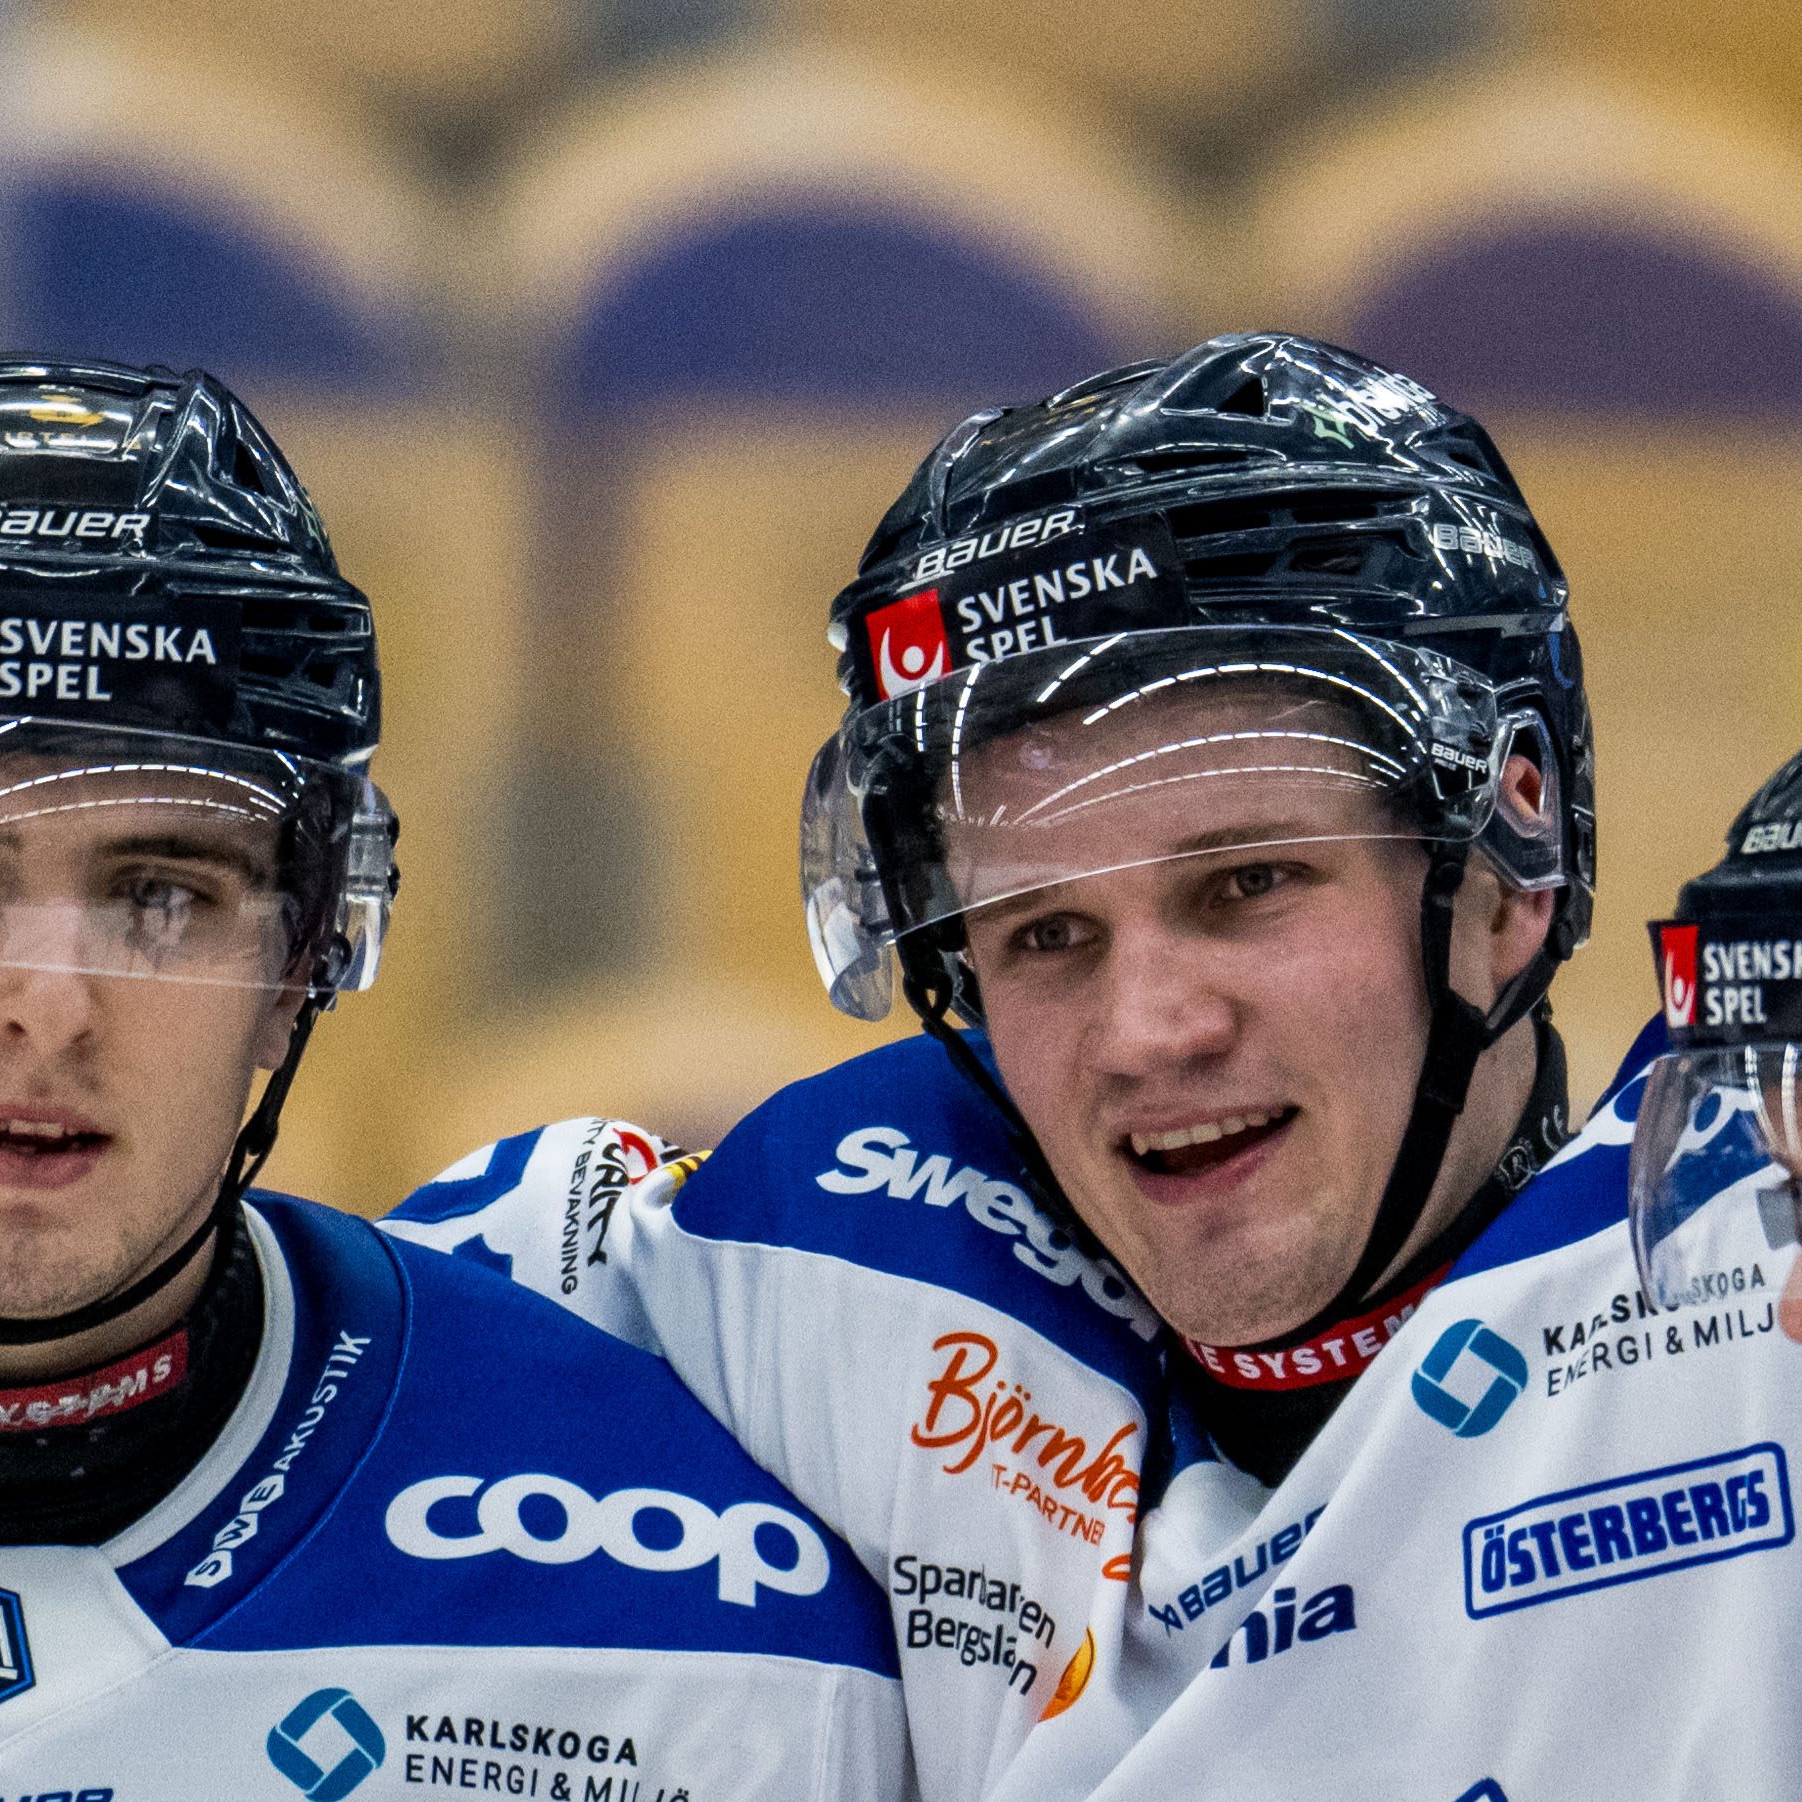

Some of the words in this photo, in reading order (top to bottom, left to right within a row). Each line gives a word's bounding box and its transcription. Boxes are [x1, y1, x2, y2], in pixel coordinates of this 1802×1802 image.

[916, 510, 1076, 580] BAUER
[957, 548, 1158, 633] SVENSKA
[0, 618, 216, 664] SVENSKA
[1431, 743, 1488, 774] BAUER
[1704, 985, 1767, 1025] SPEL
[560, 1150, 592, 1295] BEVAKNING
[1666, 1326, 1684, 1355] &
[1694, 1302, 1774, 1348] MILJ
[385, 1473, 831, 1607] coop
[1481, 1470, 1770, 1593] ÖSTERBERGS
[406, 1714, 640, 1768] KARLSKOGA
[406, 1754, 539, 1799] ENERGI
[551, 1772, 571, 1801] &
